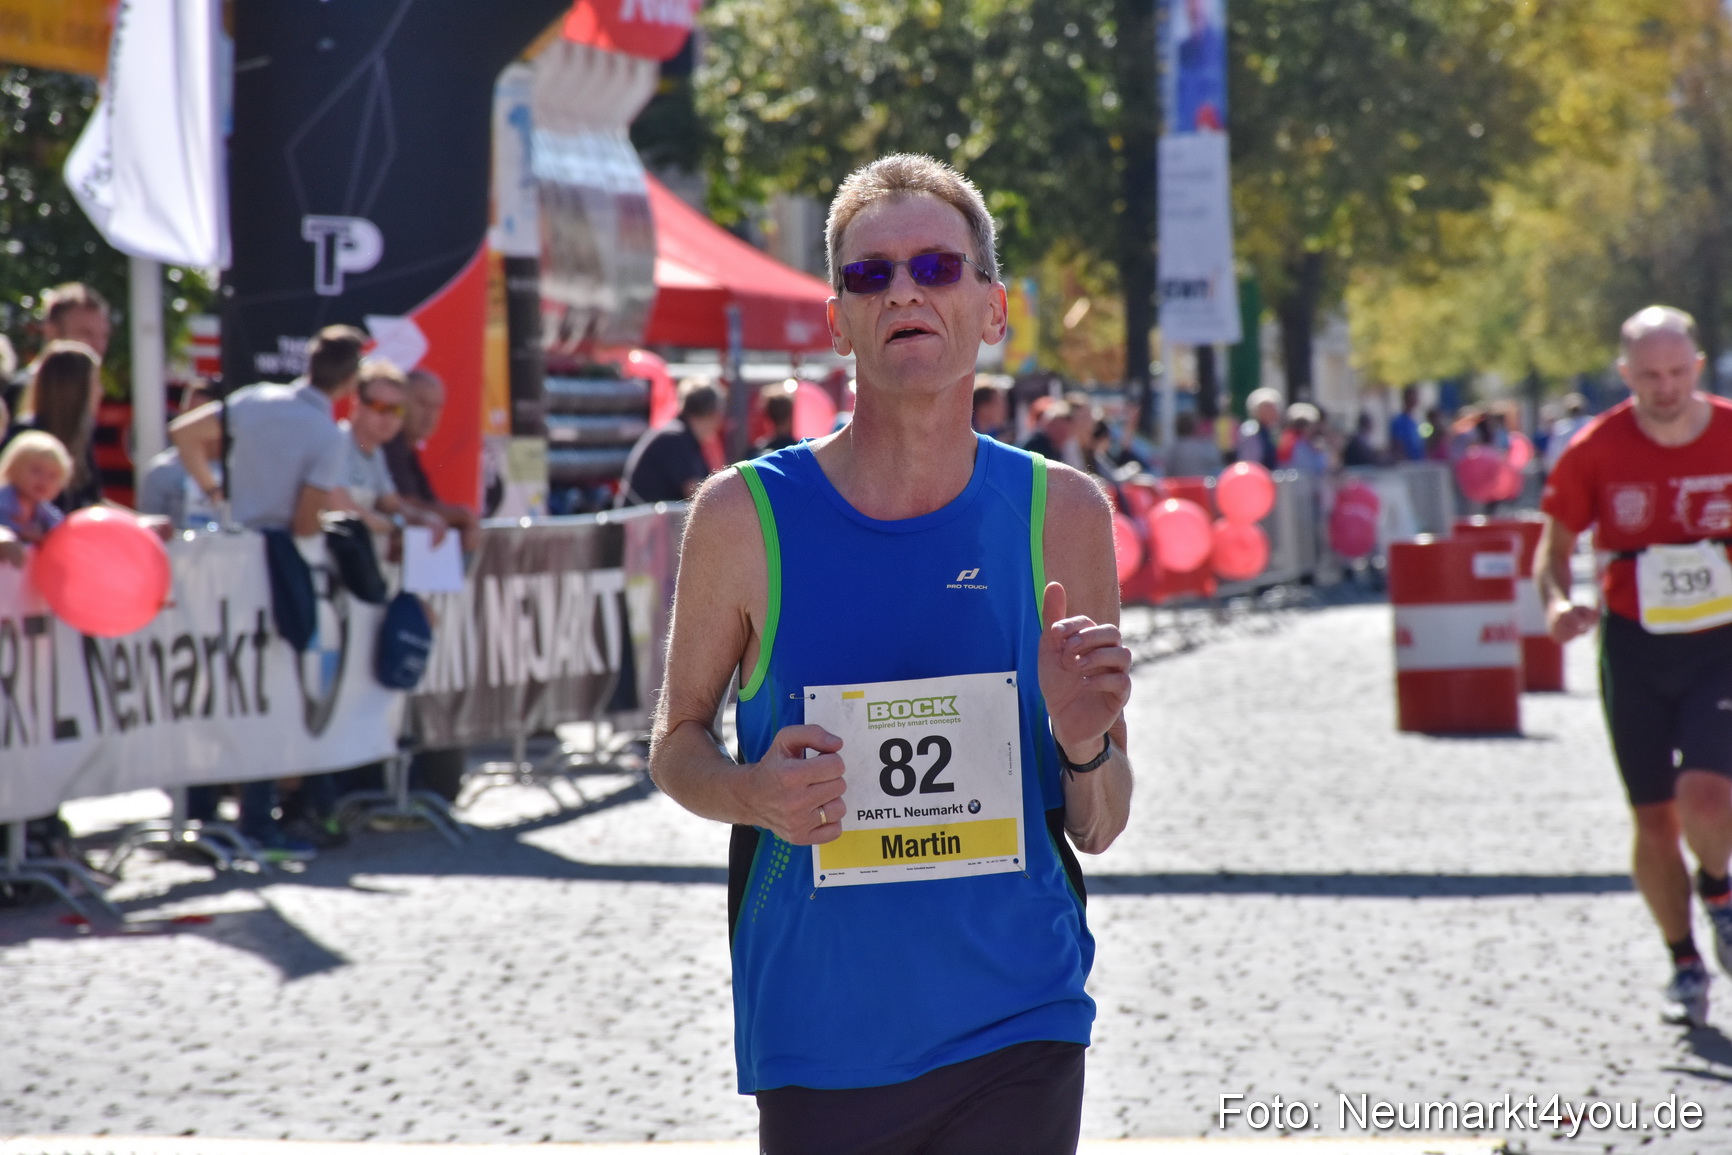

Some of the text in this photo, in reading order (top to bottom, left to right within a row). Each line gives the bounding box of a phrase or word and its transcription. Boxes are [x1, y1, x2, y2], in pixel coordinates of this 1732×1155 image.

[1660, 567, 1712, 597] 339
[867, 696, 960, 722] BOCK
[867, 716, 962, 730] inspired by smart concepts
[879, 735, 955, 797] 82
[857, 803, 963, 821] PARTL Neumarkt
[881, 831, 961, 859] Martin
